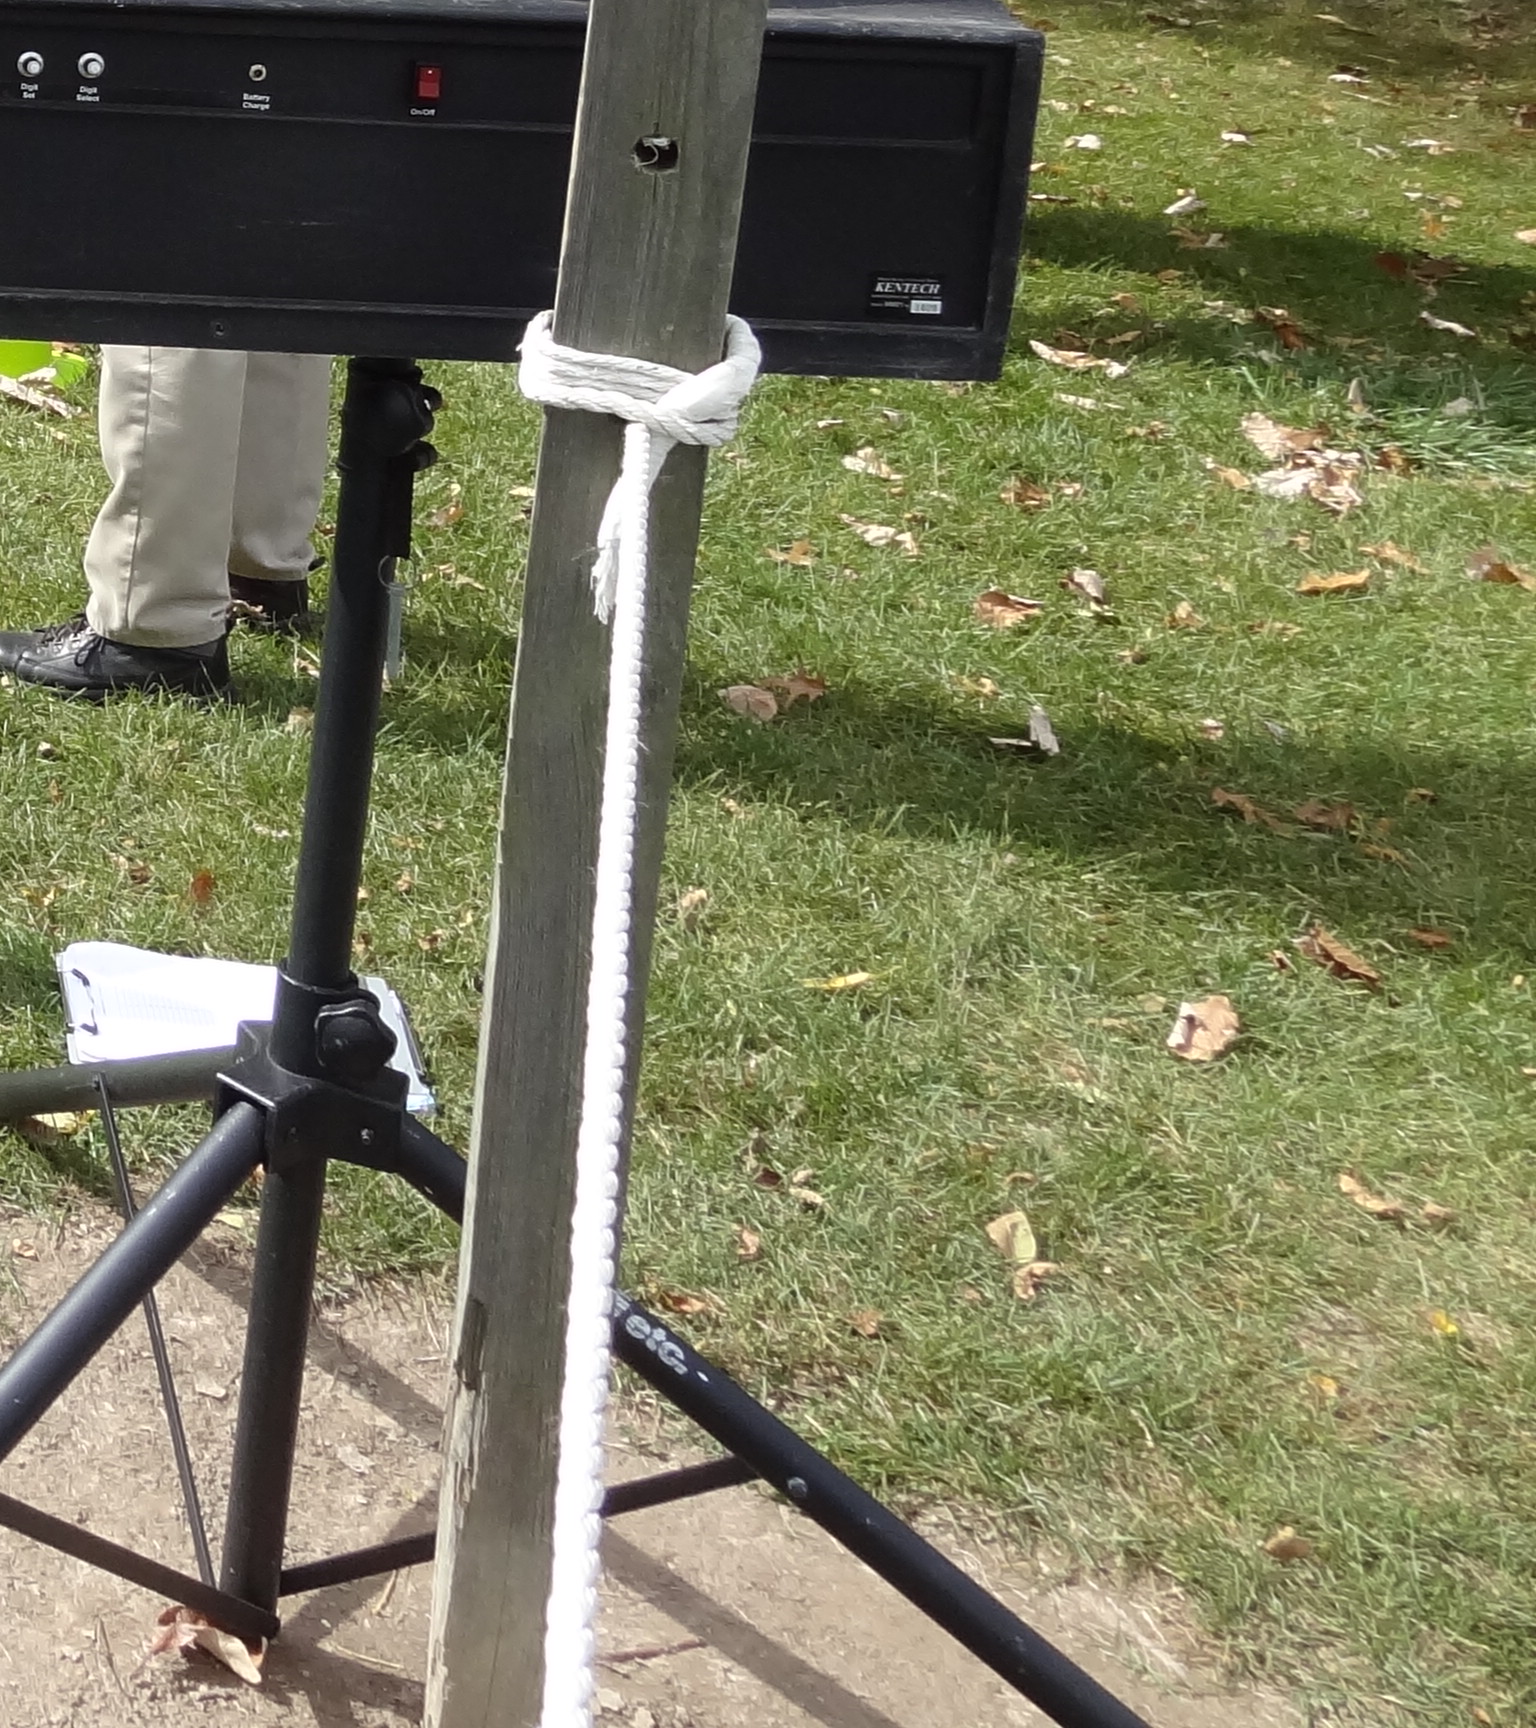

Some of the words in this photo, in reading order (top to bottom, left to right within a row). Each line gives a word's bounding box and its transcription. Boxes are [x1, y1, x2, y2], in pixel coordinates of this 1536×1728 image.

[20, 83, 39, 92] Digit
[79, 85, 98, 95] Digit
[22, 91, 36, 100] Set
[76, 93, 100, 103] Select
[242, 92, 271, 103] Battery
[242, 101, 271, 111] Charge
[410, 107, 436, 117] On/Off
[874, 282, 941, 295] KENTECH
